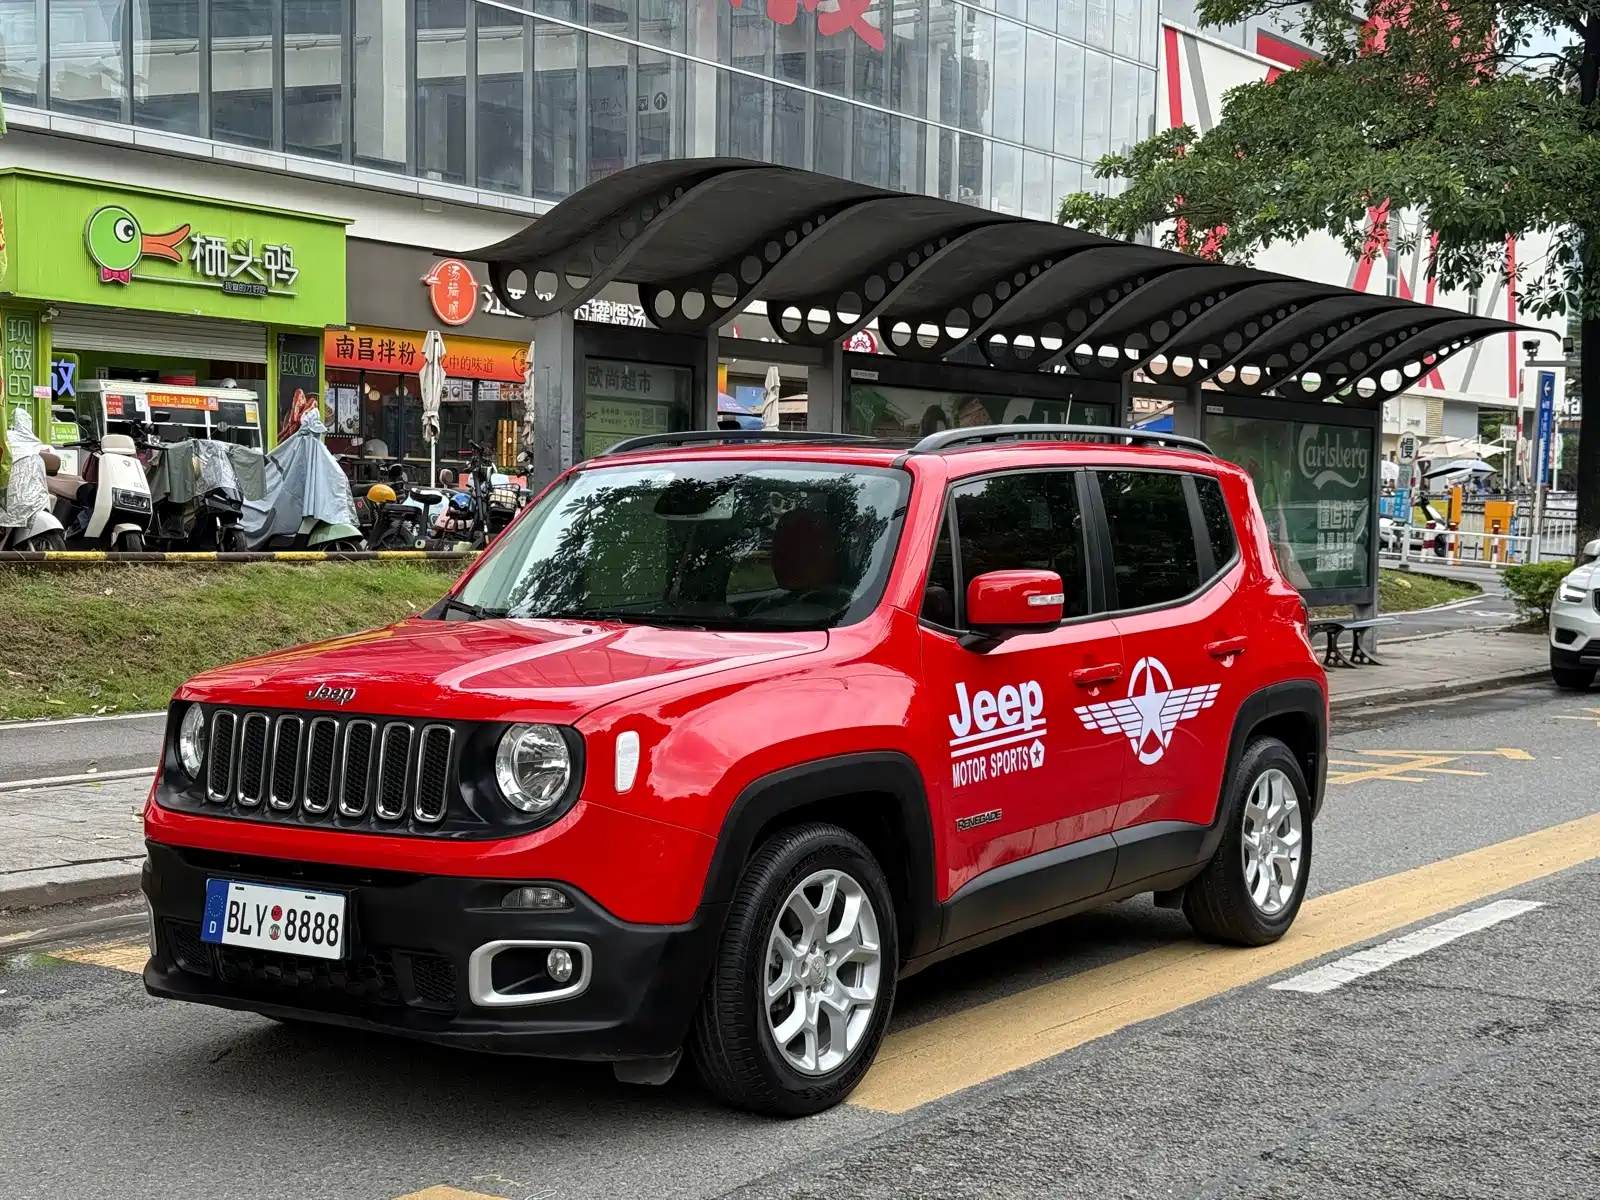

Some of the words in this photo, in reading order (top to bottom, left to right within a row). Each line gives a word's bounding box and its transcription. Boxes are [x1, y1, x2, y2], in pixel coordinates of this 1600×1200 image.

[190, 231, 300, 287] 栖头鸭
[282, 353, 315, 377] 现做
[335, 333, 416, 366] 南昌拌粉
[588, 364, 653, 394] 欧尚超市
[1298, 424, 1369, 480] Carlsberg
[1400, 437, 1414, 459] 慢
[305, 682, 357, 706] Jeep
[948, 679, 1044, 737] Jeep
[952, 756, 987, 788] MOTOR
[990, 746, 1029, 777] SPORTS
[955, 808, 1003, 832] RENEGADE
[208, 920, 217, 934] D
[226, 900, 268, 937] BLY
[284, 908, 339, 947] 8888
